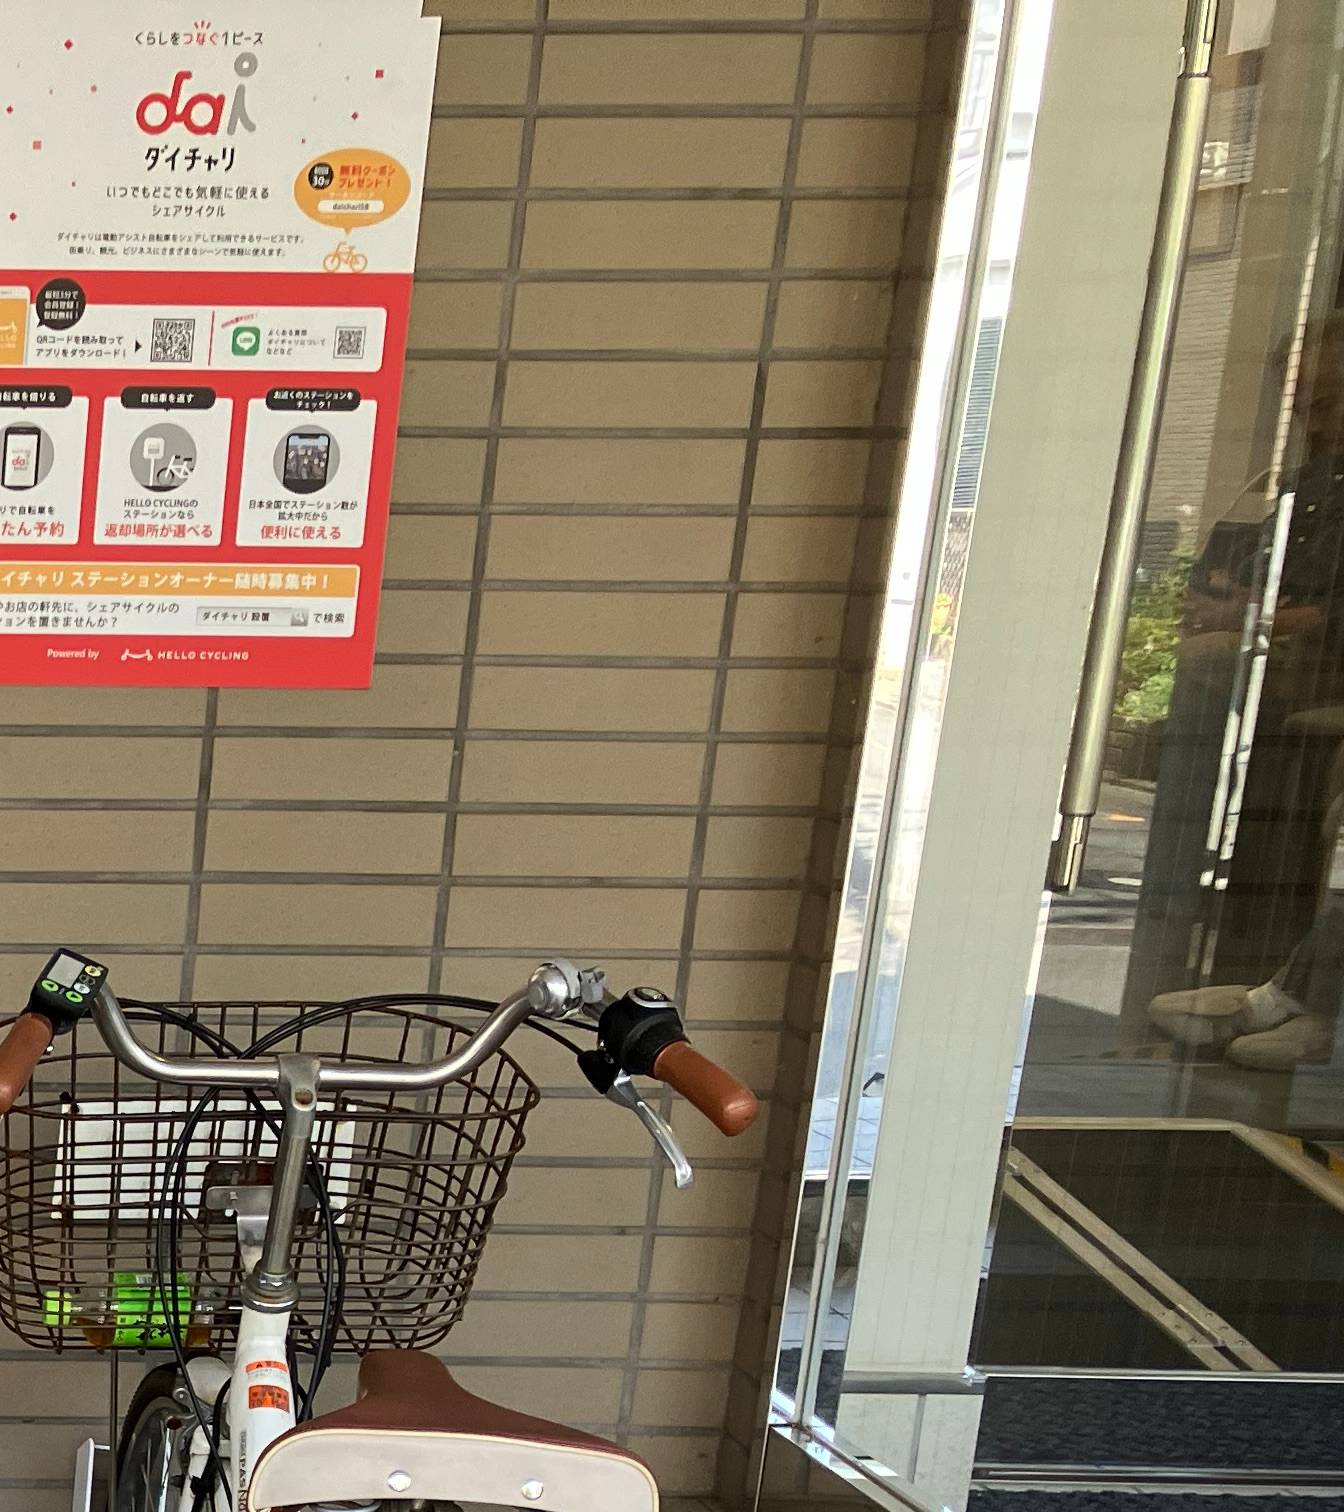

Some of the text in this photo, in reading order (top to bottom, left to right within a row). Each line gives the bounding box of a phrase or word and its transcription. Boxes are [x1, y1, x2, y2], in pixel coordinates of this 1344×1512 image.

[144, 146, 236, 172] ダイチャリ
[106, 185, 270, 200] いつでもどこでも気軽に使える
[151, 205, 226, 217] シェアサイクル
[36, 335, 125, 345] QRコードを読み取って
[35, 347, 127, 358] アプリをダウンロード！
[124, 499, 199, 508] HELLO CYCLINGの
[123, 509, 195, 520] ステーションなら
[104, 523, 213, 538] 返却場所が選べる
[260, 525, 342, 540] 便利に使える
[201, 611, 248, 622] ダイチャリ
[313, 611, 345, 624] で検索
[47, 647, 100, 661] Powered by
[157, 649, 250, 661] HELLO CYCLING
